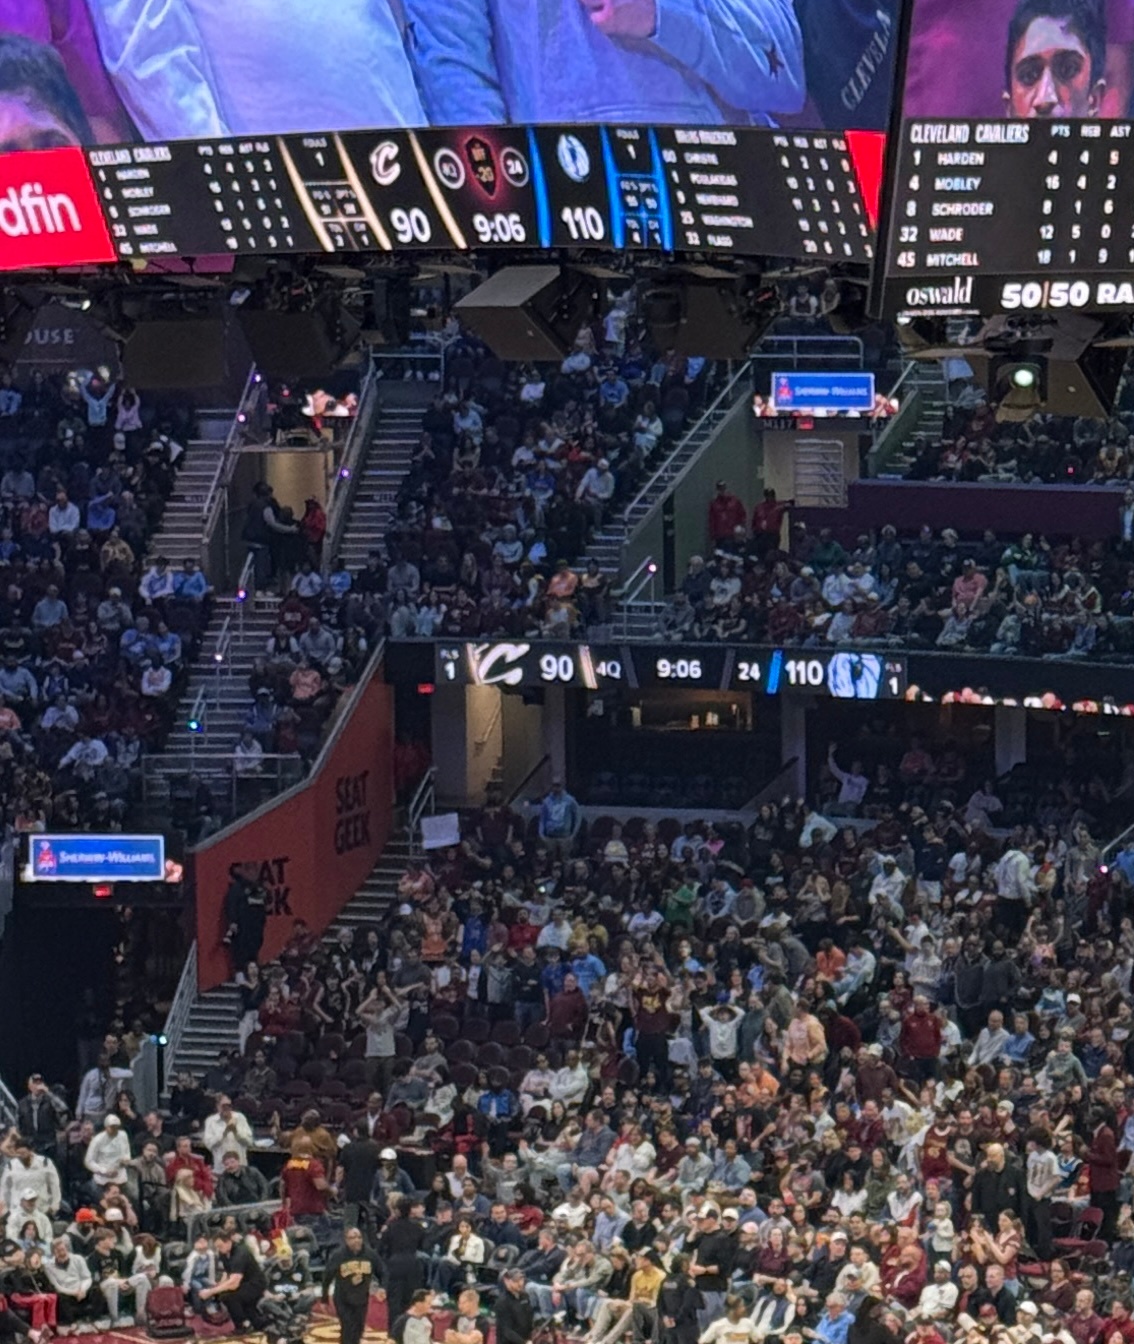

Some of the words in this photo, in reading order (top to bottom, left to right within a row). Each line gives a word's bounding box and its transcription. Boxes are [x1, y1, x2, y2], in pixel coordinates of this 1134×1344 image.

[910, 123, 970, 144] CLEVELAND
[975, 123, 1030, 144] CAVALIERS
[1051, 125, 1070, 138] PTS
[1110, 125, 1131, 138] AST
[913, 150, 921, 166] 1
[937, 152, 985, 166] HARDEN
[1048, 150, 1058, 165] 4
[1079, 150, 1089, 165] 4
[909, 175, 919, 191] 4
[934, 177, 982, 191] MOBLEY
[1077, 174, 1087, 190] 4
[1107, 174, 1116, 190] 2
[932, 202, 994, 216] SCHRODER
[1074, 199, 1081, 215] 1
[390, 208, 430, 244] 90
[473, 213, 526, 243] 9:06
[562, 207, 605, 241] 110
[899, 226, 918, 243] 32
[929, 228, 963, 242] WADE
[1039, 224, 1054, 239] 12
[1071, 224, 1081, 239] 5
[1101, 224, 1111, 239] 0
[897, 251, 916, 267] 45
[926, 253, 979, 267] MITCHELL
[1069, 249, 1076, 264] 1
[1129, 249, 1134, 264] 1
[906, 277, 973, 306] oswald
[1000, 282, 1090, 308] 50/50
[445, 661, 455, 679] 1
[888, 676, 898, 695] 1
[539, 655, 574, 681] 90
[596, 661, 622, 679] 4Q
[656, 659, 702, 679] 9:06
[738, 662, 761, 681] 24
[785, 659, 824, 685] 110
[335, 769, 369, 814] SEAT
[335, 811, 371, 855] GEEK
